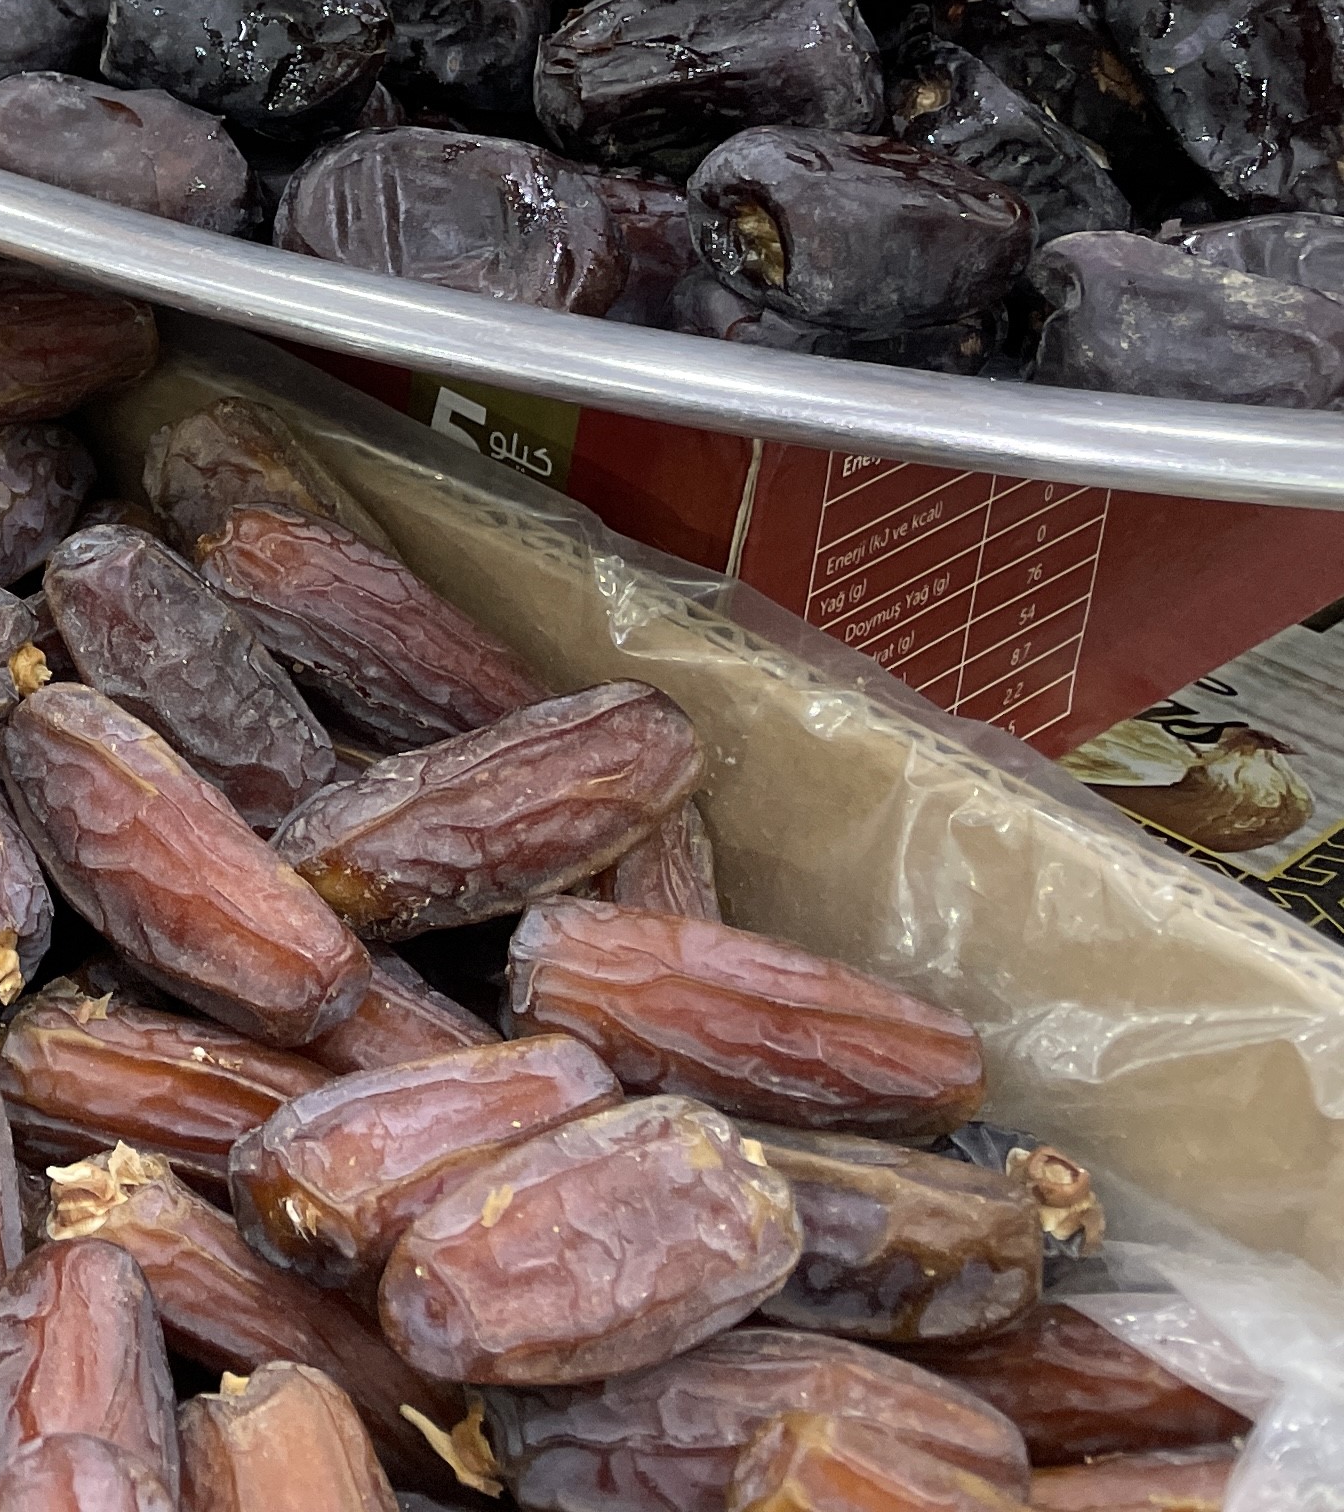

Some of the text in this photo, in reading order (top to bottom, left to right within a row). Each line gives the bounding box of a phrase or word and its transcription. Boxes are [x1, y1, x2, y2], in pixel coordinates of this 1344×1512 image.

[489, 431, 553, 477] كيلو
[1044, 483, 1054, 502] 0
[1037, 524, 1047, 543] 0
[826, 540, 866, 576] Enerji
[892, 521, 909, 540] ve
[1027, 562, 1043, 584] 76
[820, 577, 868, 617] Yağ (g)
[844, 571, 951, 643] Doymuş Yağ (g)
[1018, 603, 1036, 626] 54
[897, 629, 916, 655] (g)
